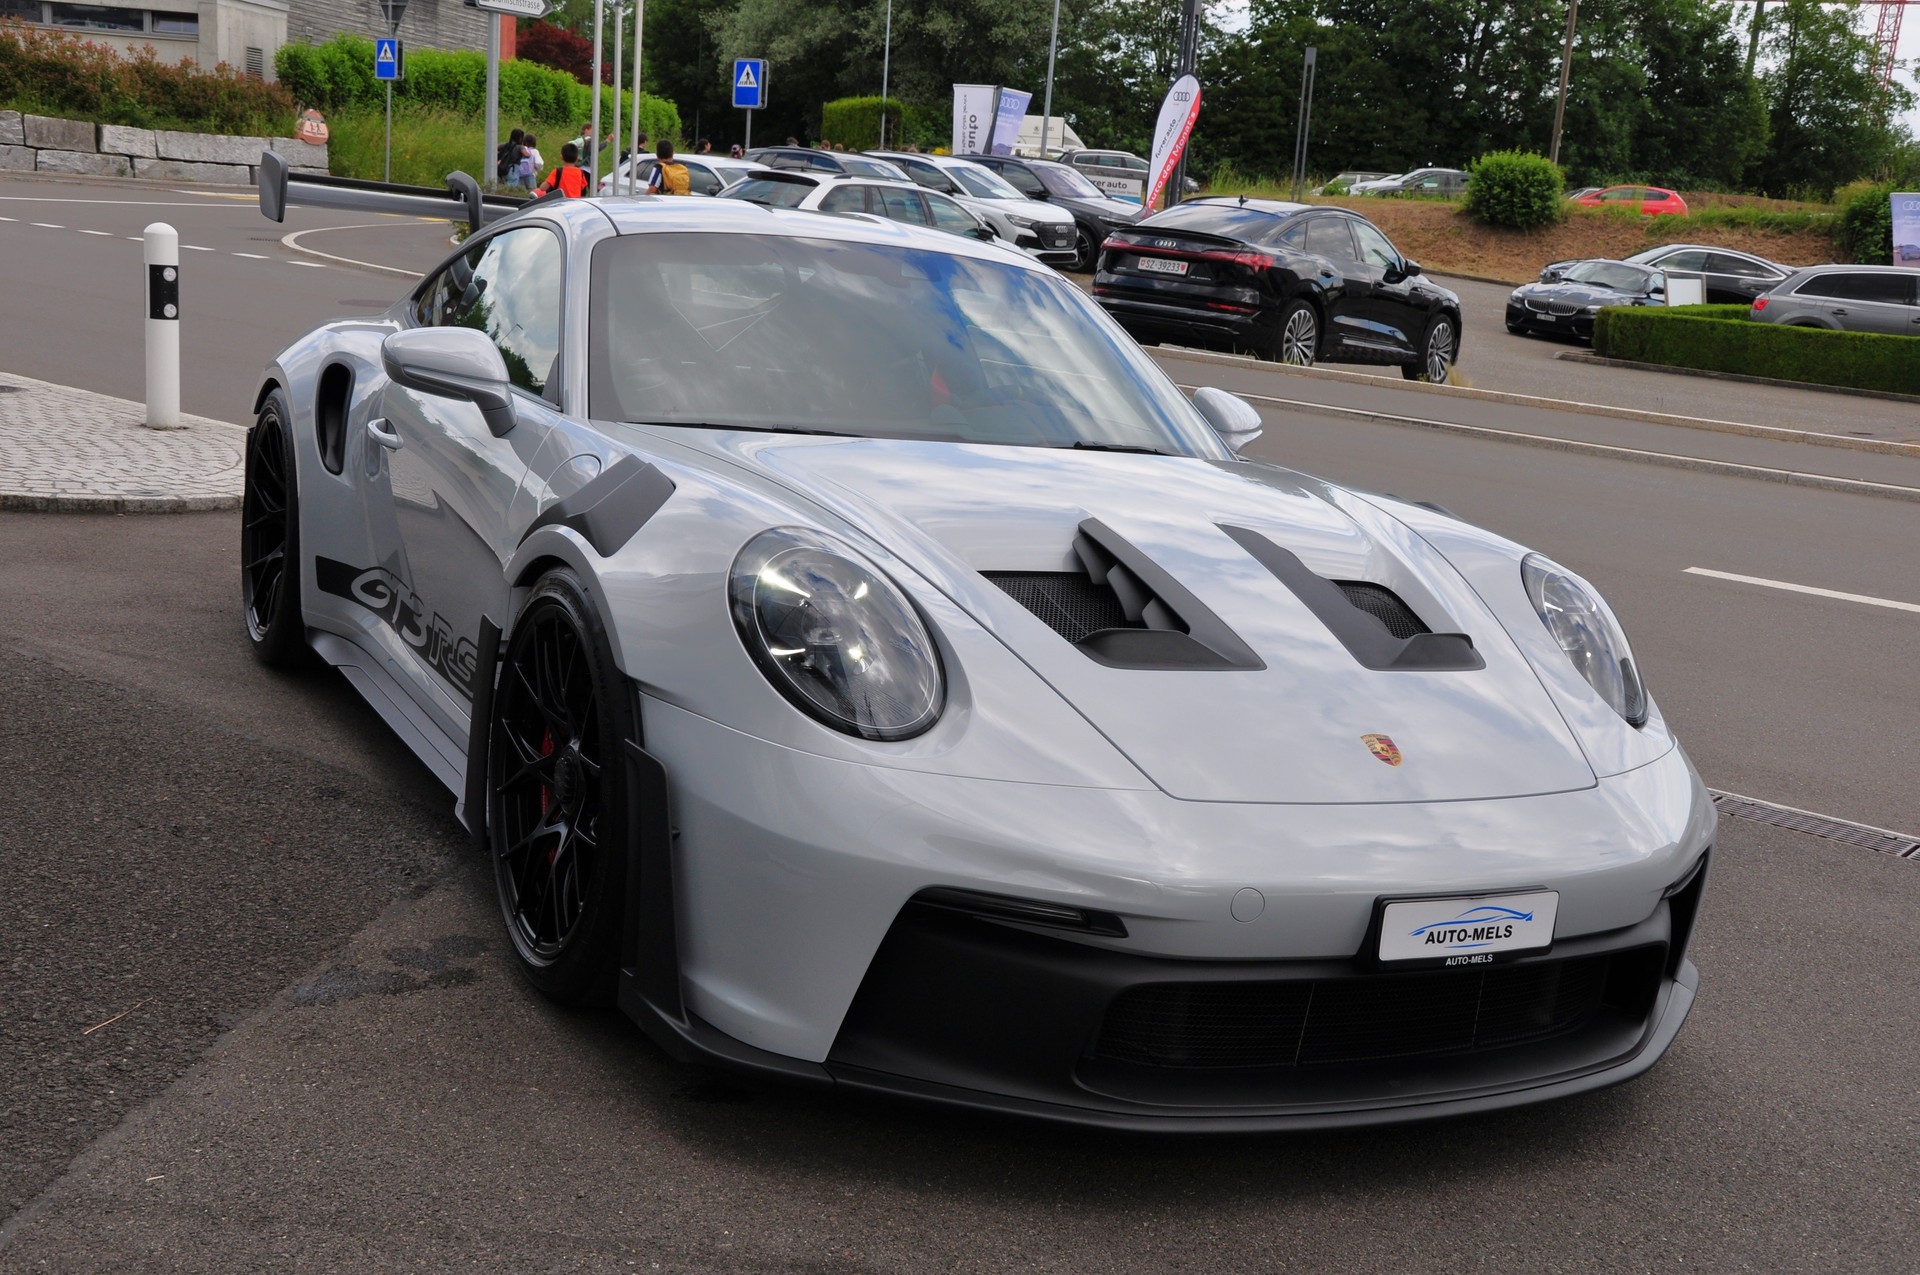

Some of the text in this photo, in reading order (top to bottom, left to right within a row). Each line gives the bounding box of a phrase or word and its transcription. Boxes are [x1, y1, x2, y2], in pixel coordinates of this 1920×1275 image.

[1155, 137, 1168, 159] furrer
[1166, 118, 1177, 137] auto
[1107, 181, 1128, 190] auto
[1148, 180, 1163, 208] Auto
[1162, 158, 1175, 179] des
[1425, 924, 1513, 945] AUTO-MELS
[1445, 953, 1494, 966] AUTO-MELS
